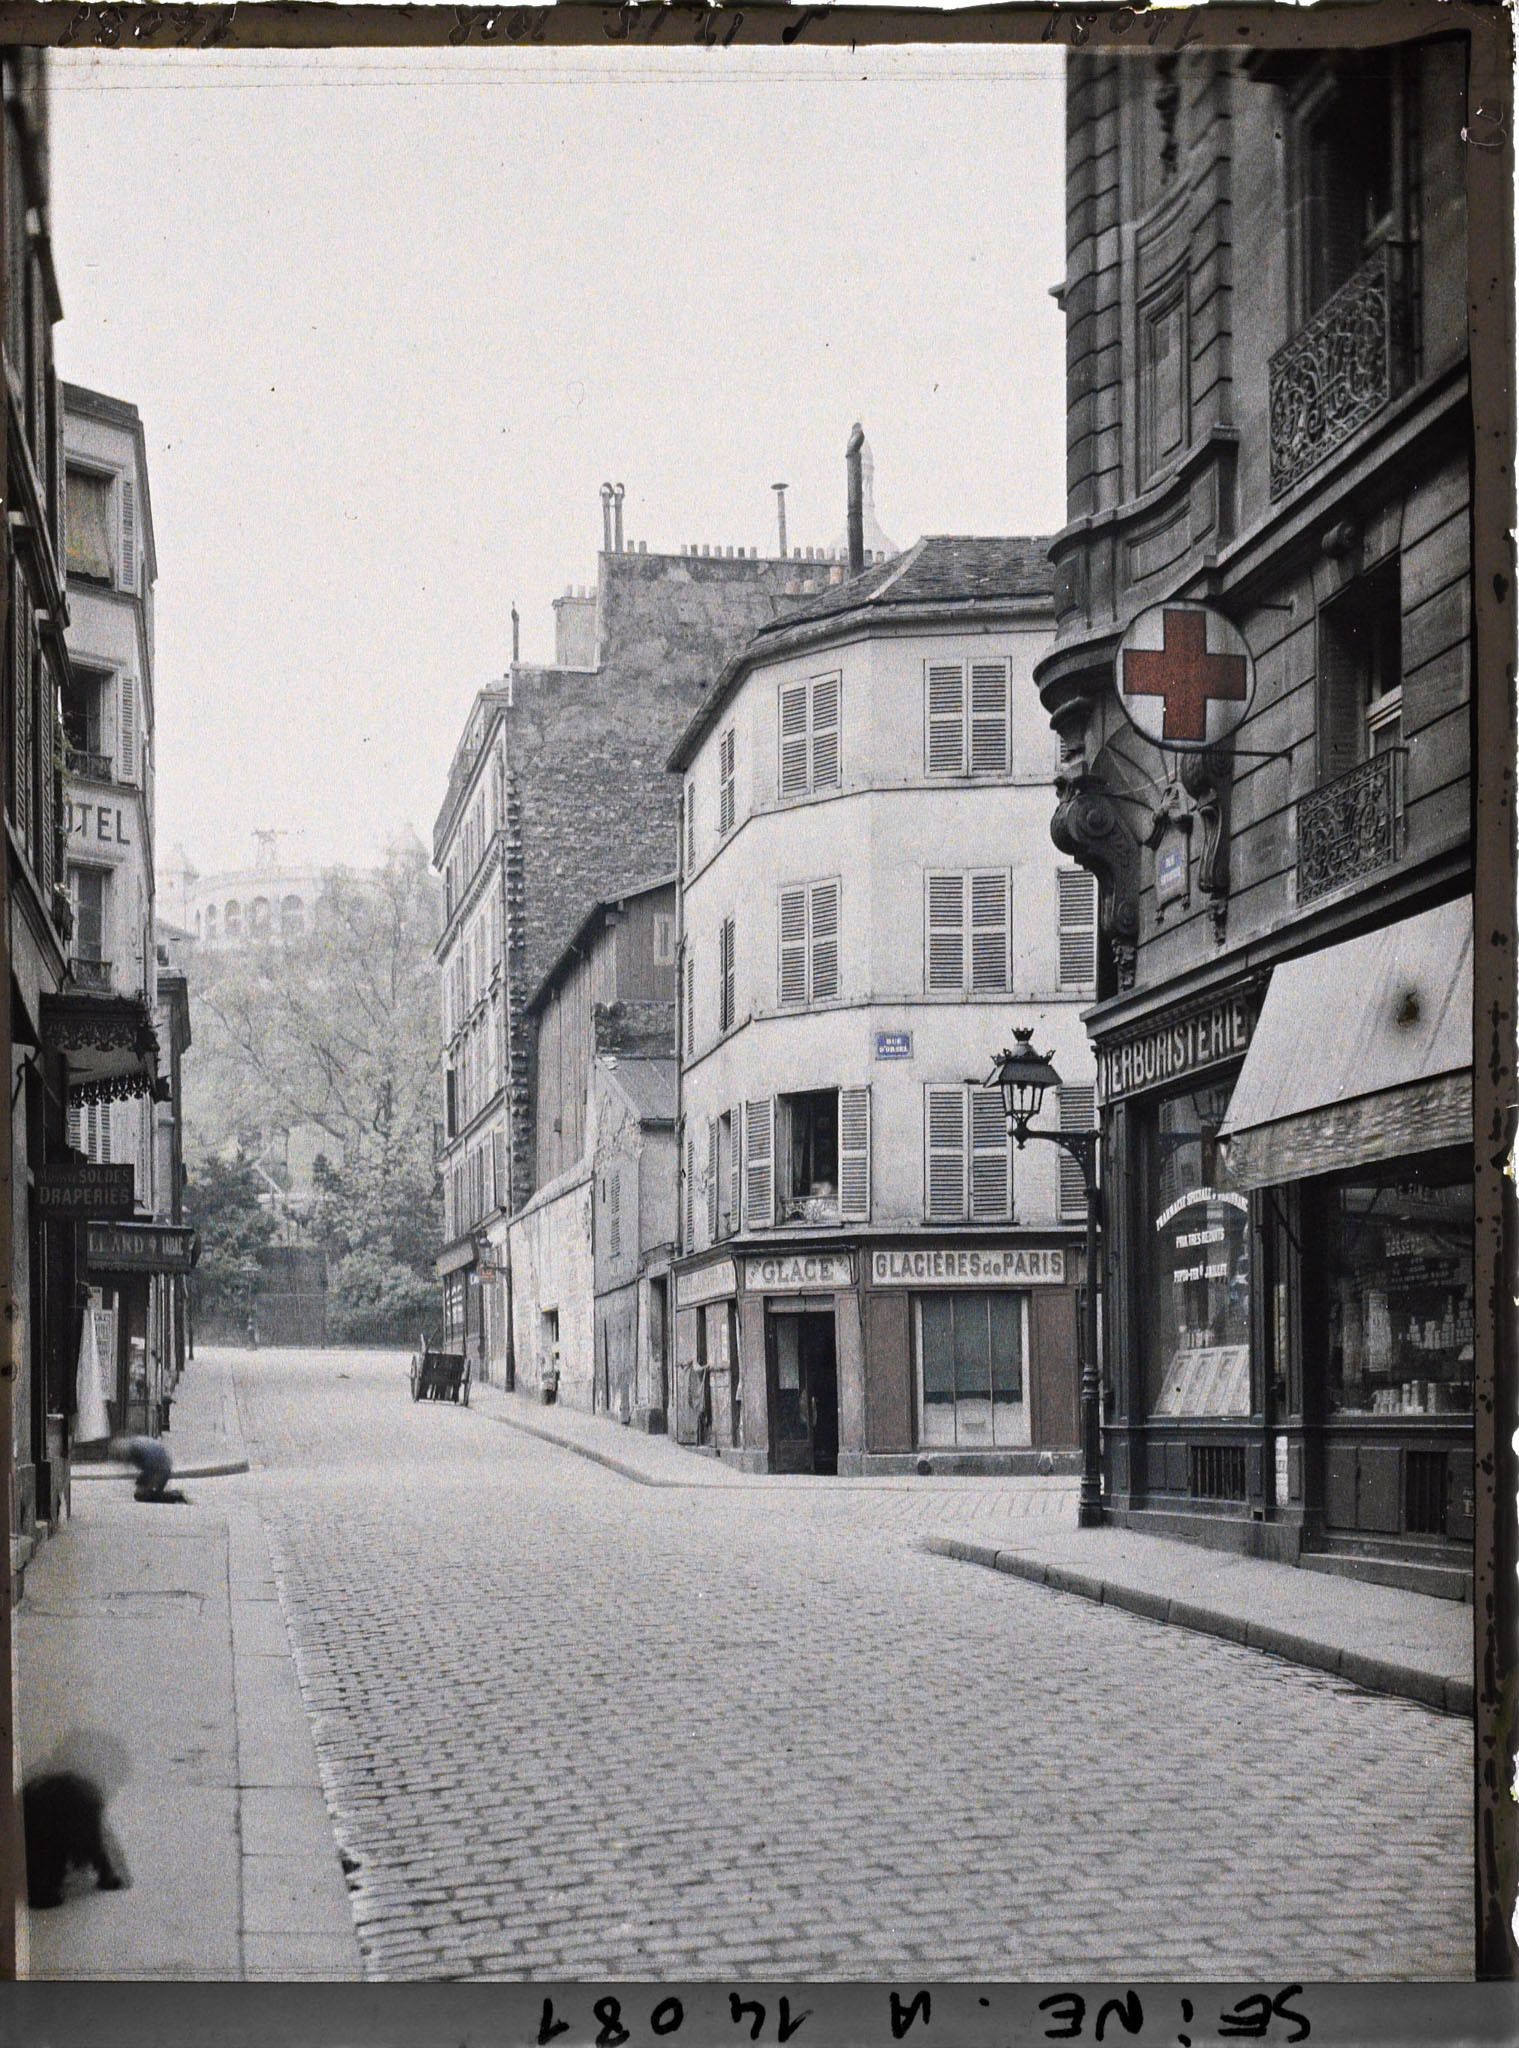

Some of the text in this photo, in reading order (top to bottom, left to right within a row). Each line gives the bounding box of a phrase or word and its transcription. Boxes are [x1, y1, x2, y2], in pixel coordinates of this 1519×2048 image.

[39, 1186, 130, 1206] DRAPERIES
[761, 1257, 834, 1284] GLACE
[983, 1260, 1001, 1275] de
[1002, 1252, 1063, 1276] PARIS
[889, 1990, 931, 2039] A
